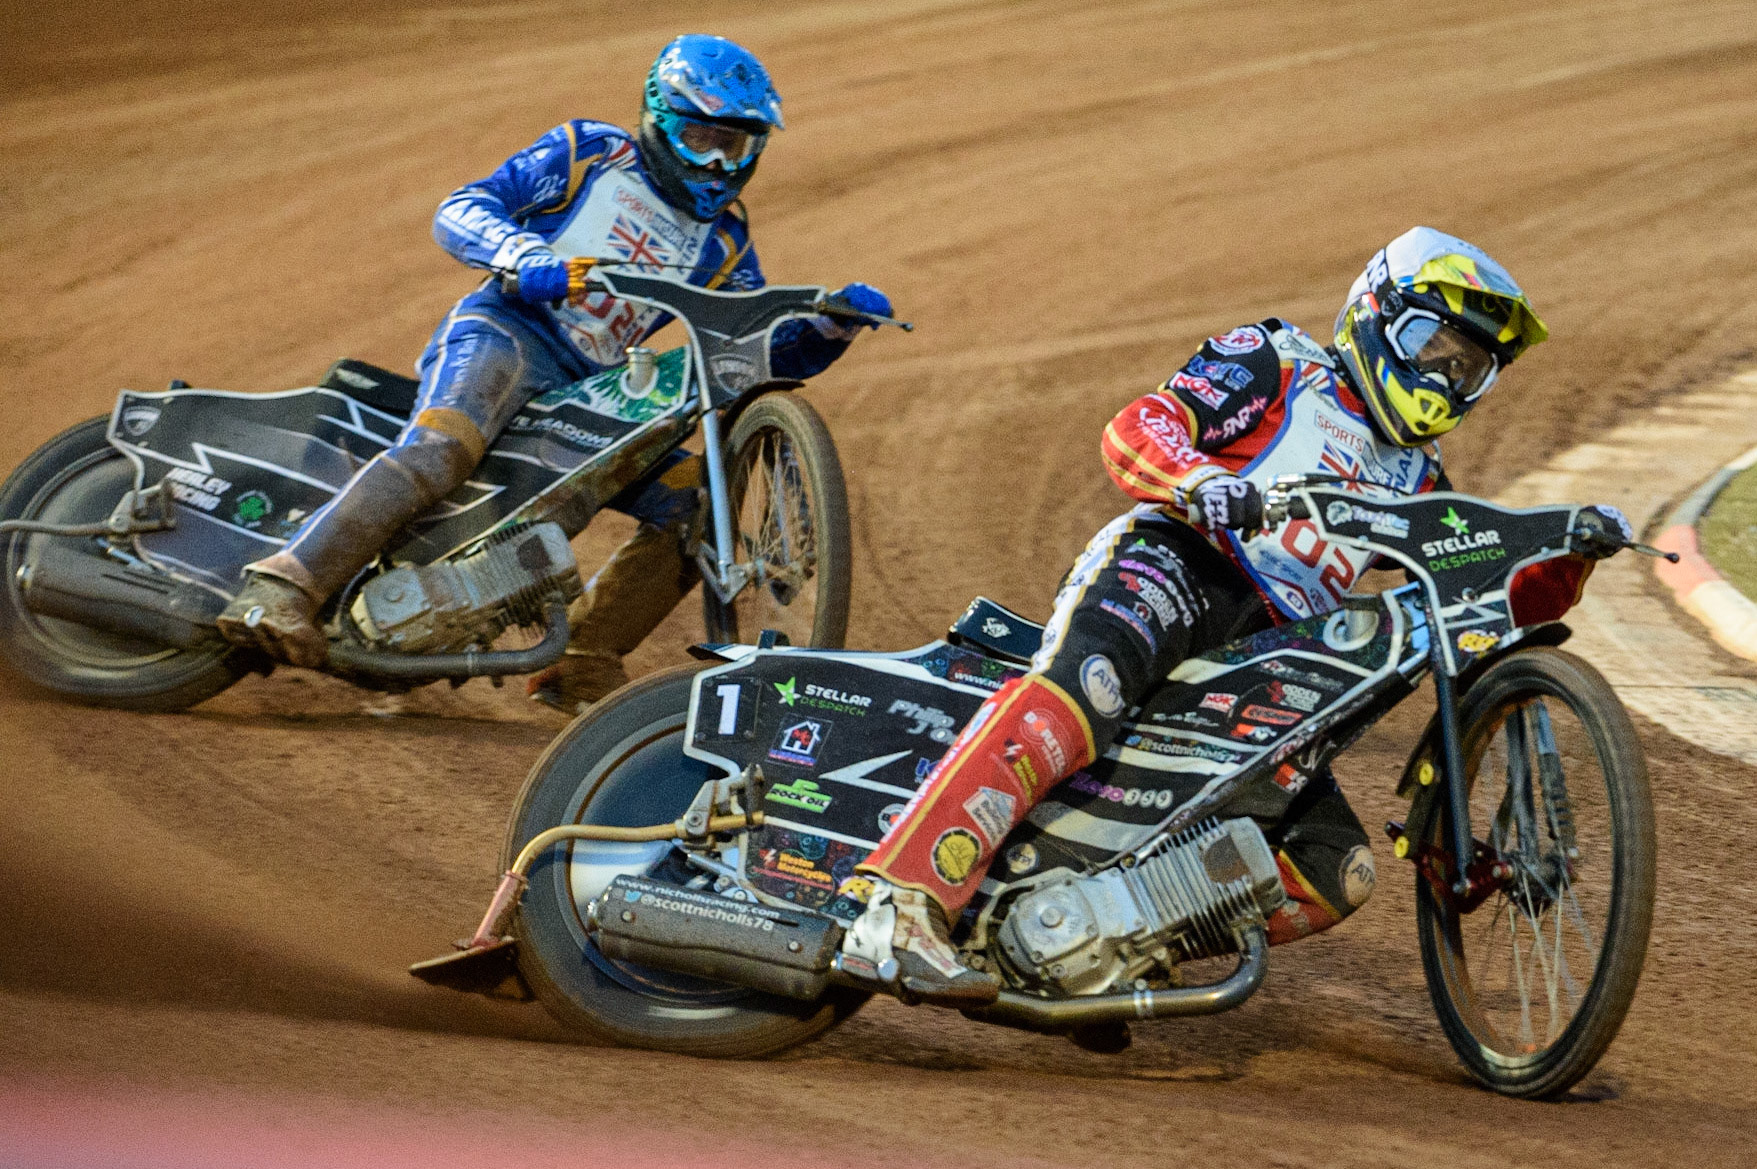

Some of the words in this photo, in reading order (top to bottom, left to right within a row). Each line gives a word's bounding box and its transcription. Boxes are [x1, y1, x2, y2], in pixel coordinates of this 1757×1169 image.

[1318, 414, 1363, 454] SPORTS
[1421, 530, 1501, 558] STELLAR
[1429, 548, 1506, 573] DESPATCH
[717, 684, 741, 735] 1
[800, 696, 867, 718] DESPATCH
[805, 684, 872, 707] STELLAR
[615, 877, 780, 919] www.nichollsracing.com
[640, 893, 775, 933] @scottnicholls78
